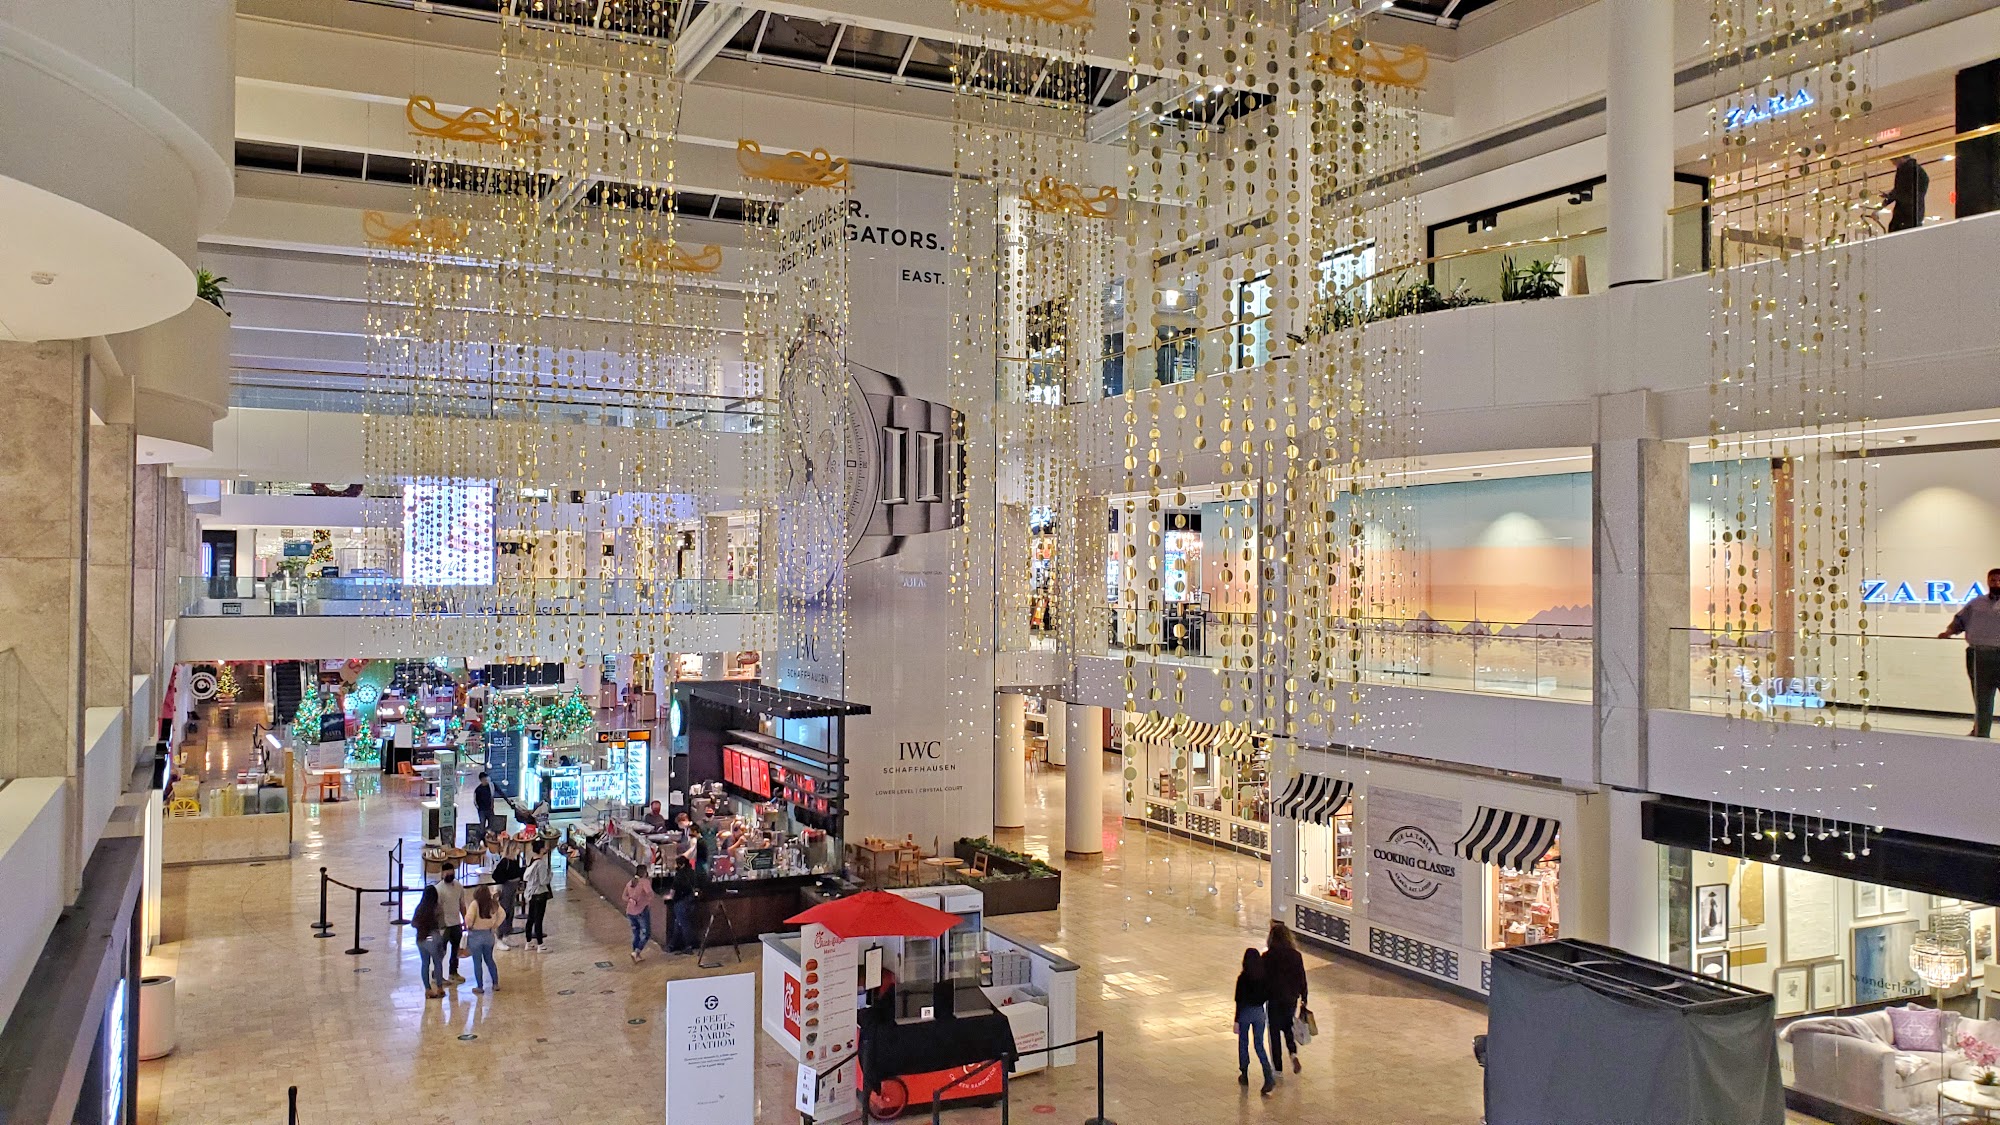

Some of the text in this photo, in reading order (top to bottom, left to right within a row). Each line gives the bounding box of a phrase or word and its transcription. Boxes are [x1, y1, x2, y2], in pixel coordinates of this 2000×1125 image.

[1725, 89, 1814, 129] ZARA
[902, 269, 945, 285] EAST.
[1861, 579, 1989, 605] ZARA
[796, 632, 820, 662] IWC
[899, 740, 941, 760] IWC
[883, 763, 956, 775] SCHAFFHAUSEN
[1373, 848, 1456, 878] COOKING CLASSES
[695, 1013, 728, 1025] 6 FEET
[687, 1021, 735, 1035] 72 INCHES
[691, 1030, 731, 1043] 2 YARDS
[694, 1038, 736, 1051] FATHOM
